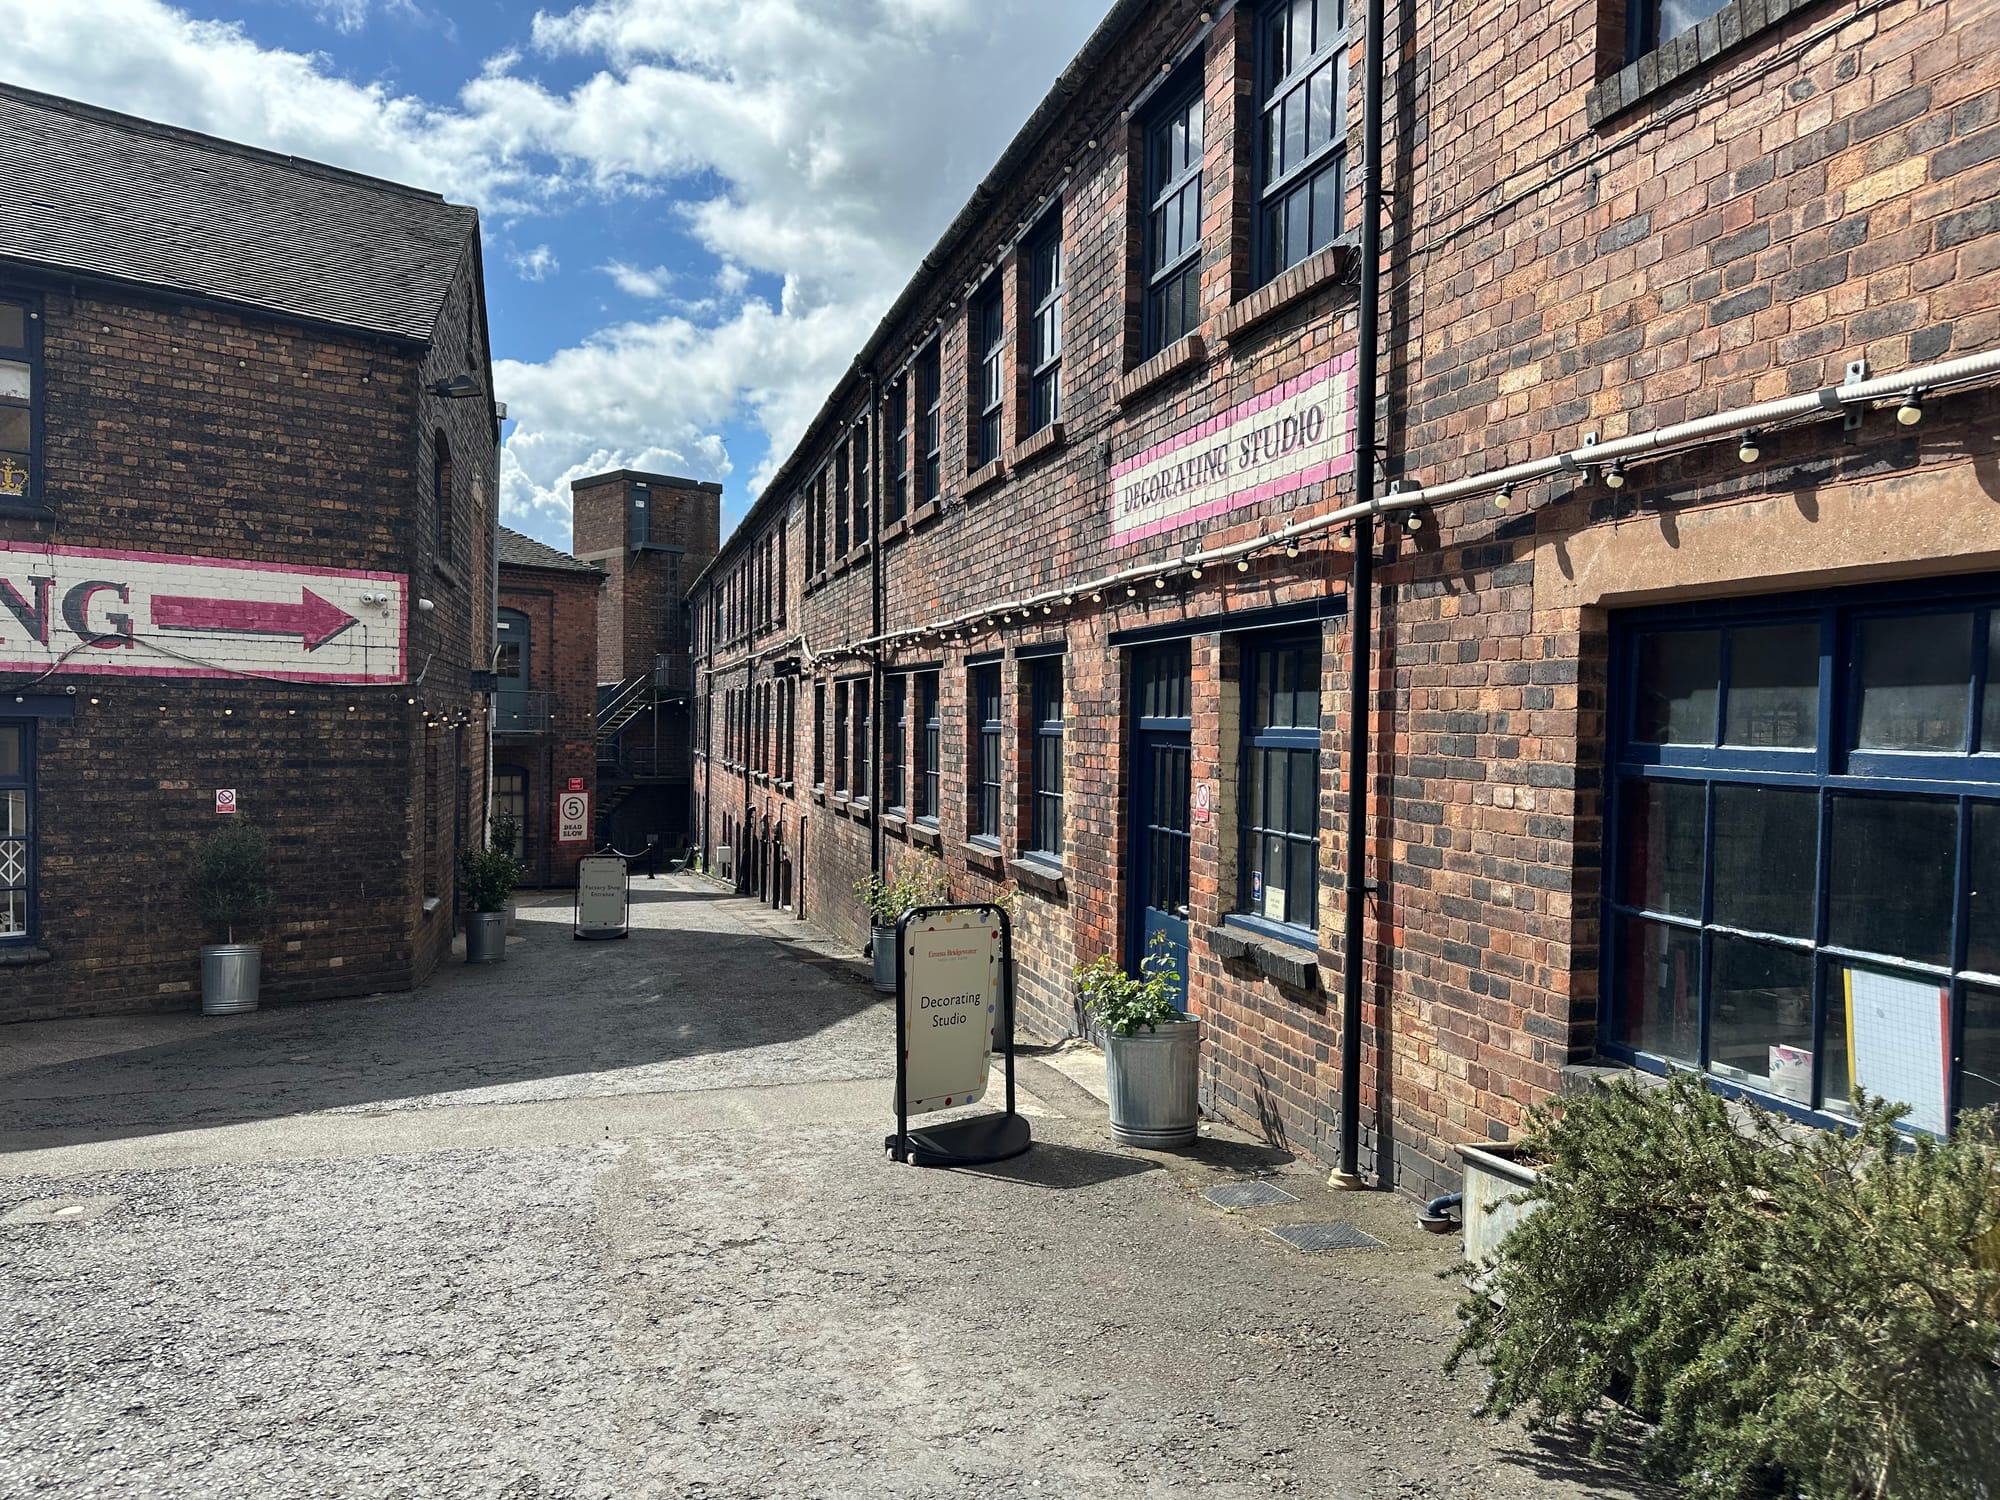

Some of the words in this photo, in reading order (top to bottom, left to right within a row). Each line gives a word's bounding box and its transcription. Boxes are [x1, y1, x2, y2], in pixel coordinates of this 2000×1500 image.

[1124, 444, 1228, 513] DECORATING
[1239, 405, 1325, 469] STUDIO
[568, 801, 579, 816] 5
[920, 991, 981, 1009] Decorating
[932, 1012, 967, 1027] Studio
